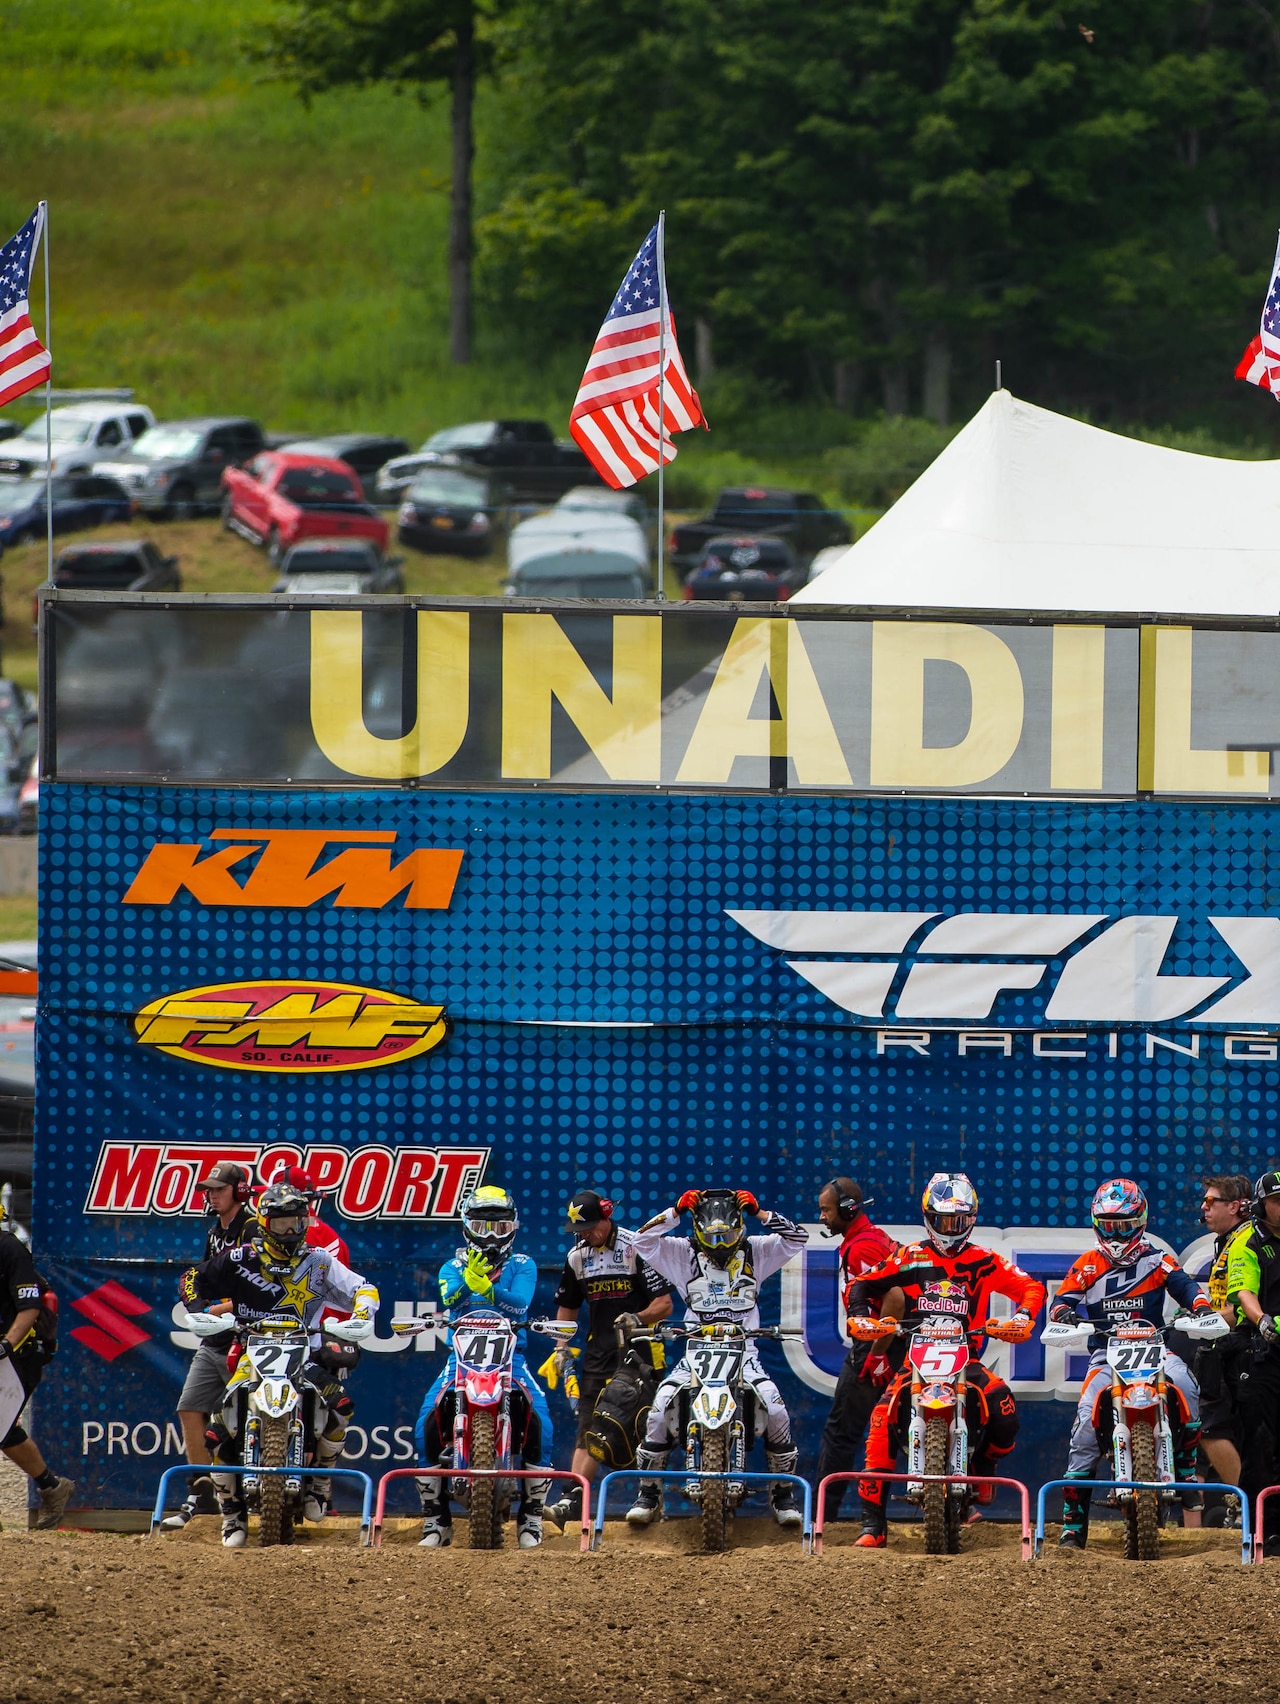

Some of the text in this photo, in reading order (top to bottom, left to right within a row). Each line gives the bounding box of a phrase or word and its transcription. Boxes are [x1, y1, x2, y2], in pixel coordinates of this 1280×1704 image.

[122, 829, 464, 909] KTM
[137, 992, 446, 1050] FMF
[241, 1052, 340, 1064] SO. CALIF.
[877, 1030, 1278, 1062] RACING
[17, 1287, 39, 1299] 978
[237, 1265, 283, 1297] THOR
[918, 1297, 968, 1314] Red Bull
[1102, 1298, 1144, 1309] HITACHI
[254, 1346, 305, 1378] 21
[463, 1335, 505, 1365] 41
[694, 1350, 742, 1380] 377
[919, 1345, 959, 1377] 5
[1115, 1347, 1162, 1370] 274
[913, 1430, 921, 1469] DLOP
[1118, 1436, 1126, 1475] DNLOP
